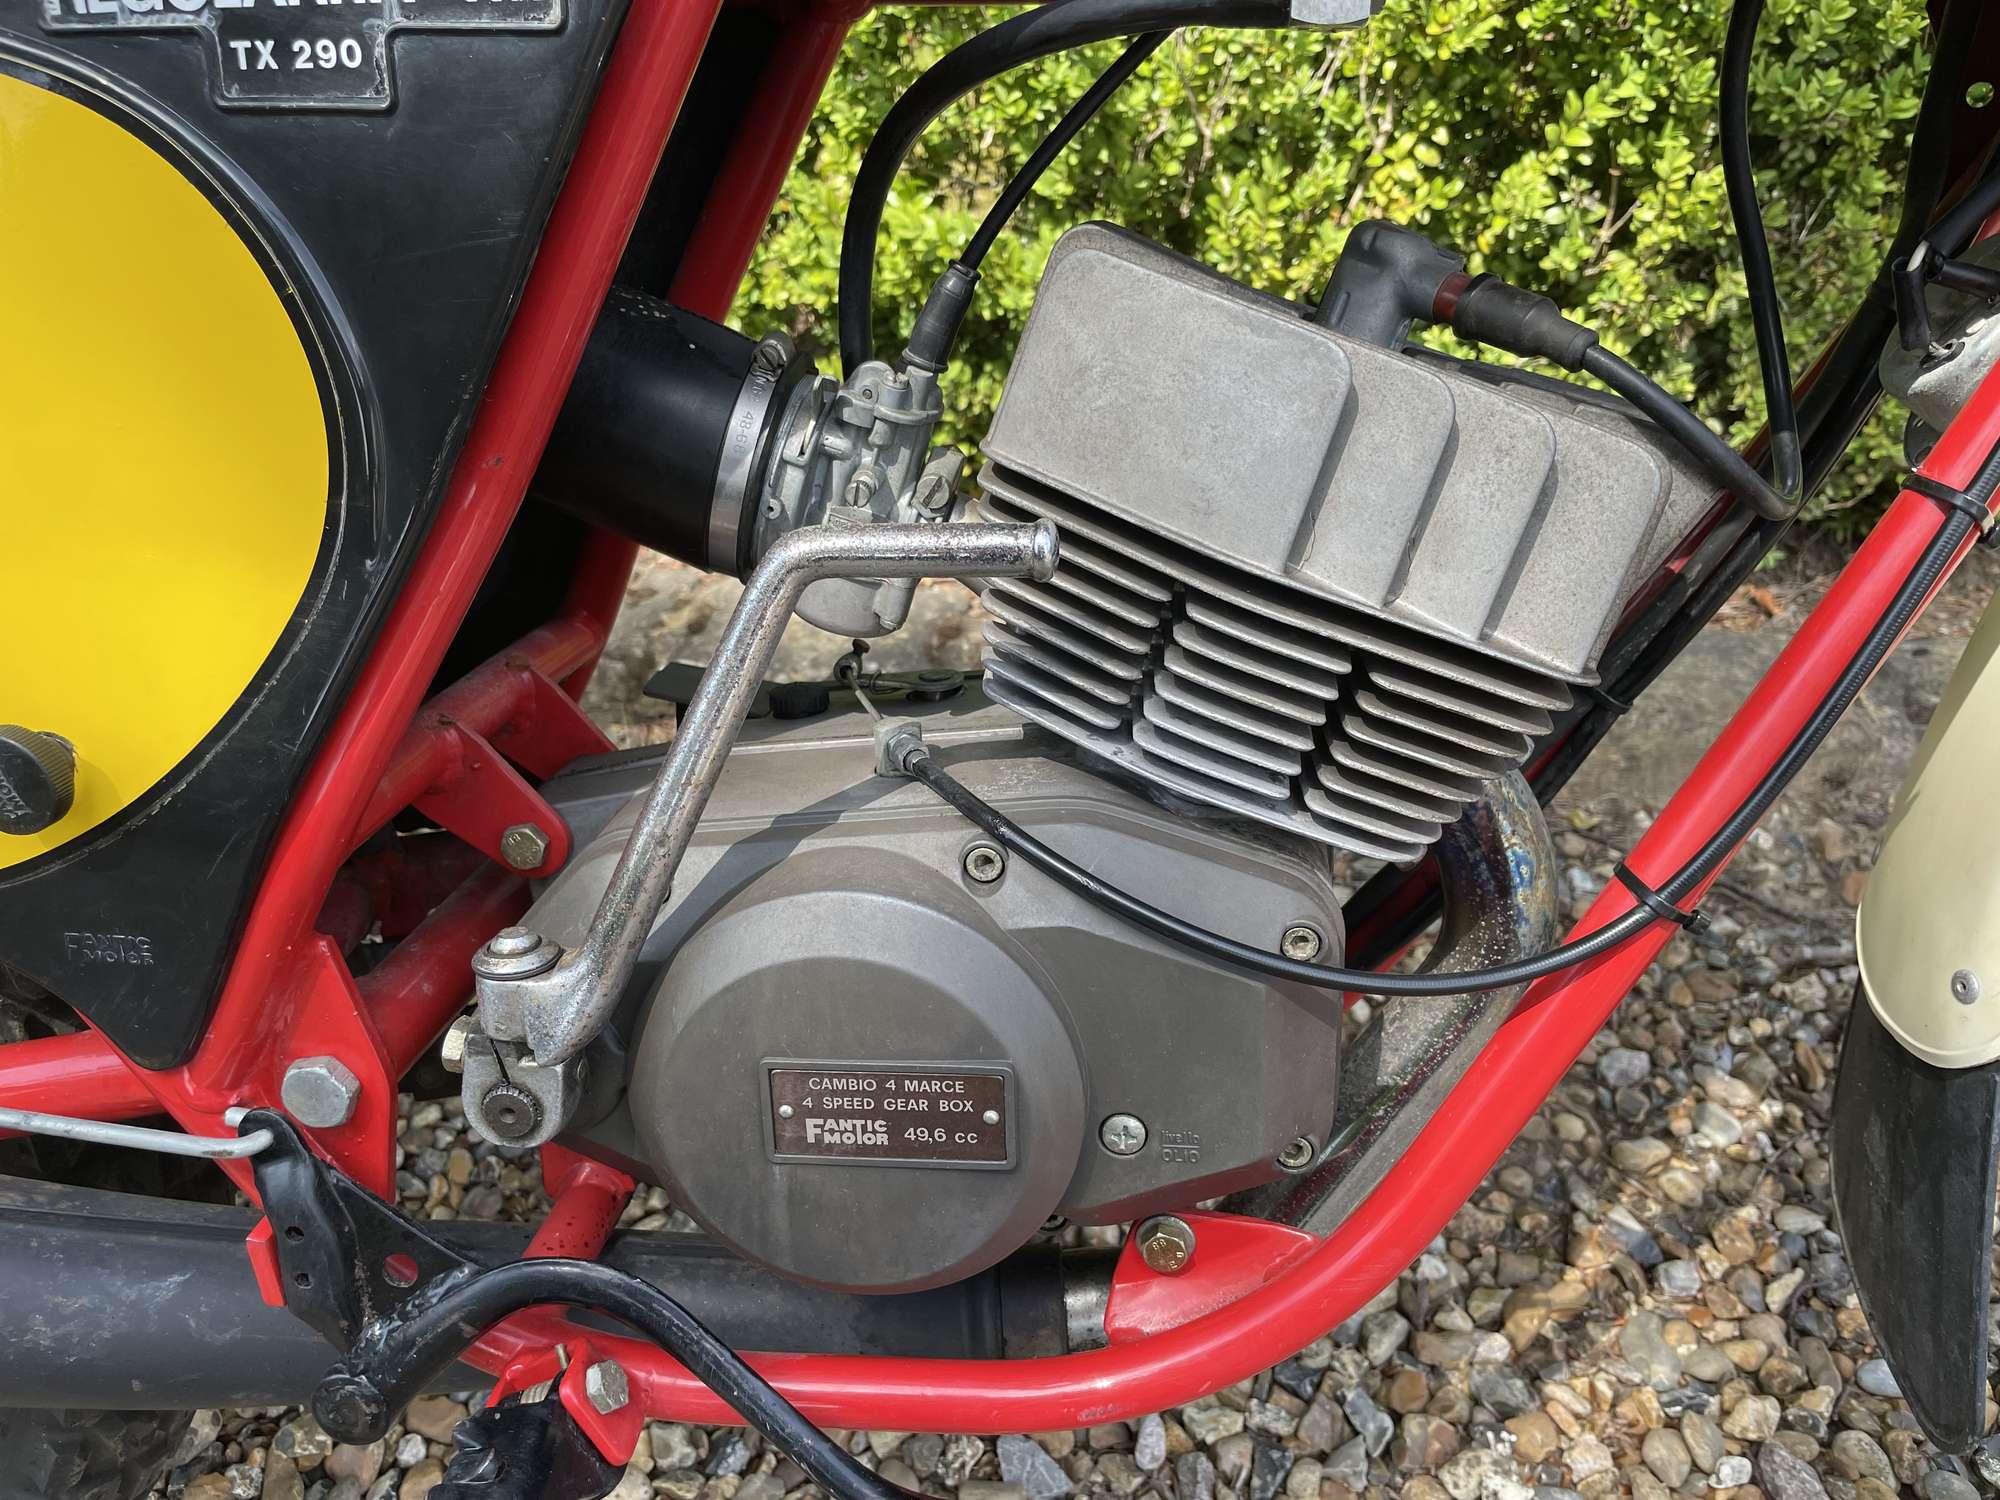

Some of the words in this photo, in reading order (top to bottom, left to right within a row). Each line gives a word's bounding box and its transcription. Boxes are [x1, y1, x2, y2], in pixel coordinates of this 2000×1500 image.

[229, 40, 279, 70] TX
[292, 38, 362, 69] 290
[809, 1078, 877, 1091] CAMBIO
[885, 1079, 896, 1091] 4
[904, 1080, 965, 1093] MARCE
[802, 1097, 813, 1109] 4
[823, 1097, 875, 1110] SPEED
[883, 1099, 929, 1112] GEAR
[939, 1100, 974, 1112] BOX
[805, 1118, 888, 1144] FANTIC
[823, 1131, 889, 1145] MOTOR
[904, 1127, 946, 1144] 49,6
[954, 1132, 978, 1143] cc
